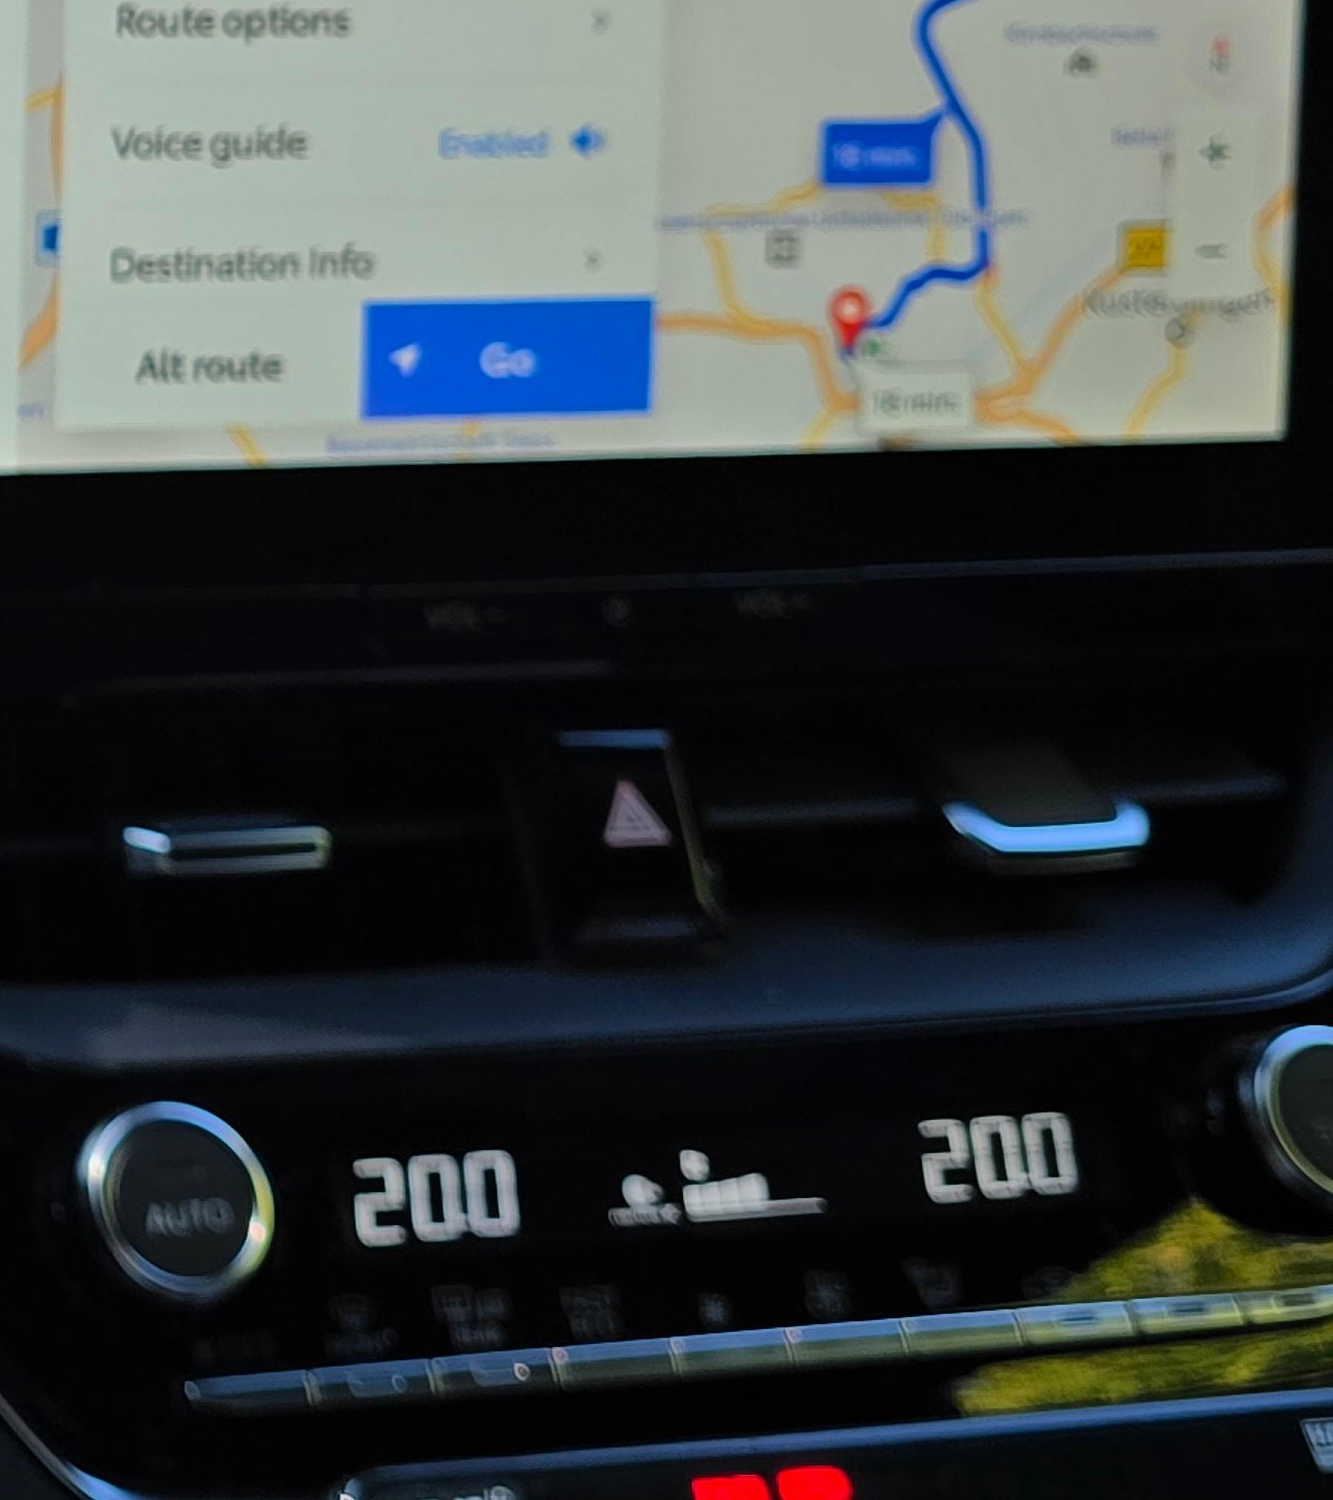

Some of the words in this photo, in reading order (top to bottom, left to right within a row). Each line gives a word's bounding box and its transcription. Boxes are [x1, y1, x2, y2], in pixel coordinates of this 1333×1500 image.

[115, 1, 216, 38] Route
[221, 2, 353, 46] options
[110, 122, 204, 161] Voice
[208, 120, 310, 169] guide
[438, 127, 550, 159] Enabled
[108, 246, 302, 283] Destination
[133, 347, 185, 383] Alt
[190, 348, 286, 384] route
[479, 341, 539, 379] Go
[146, 1197, 235, 1237] AUTO
